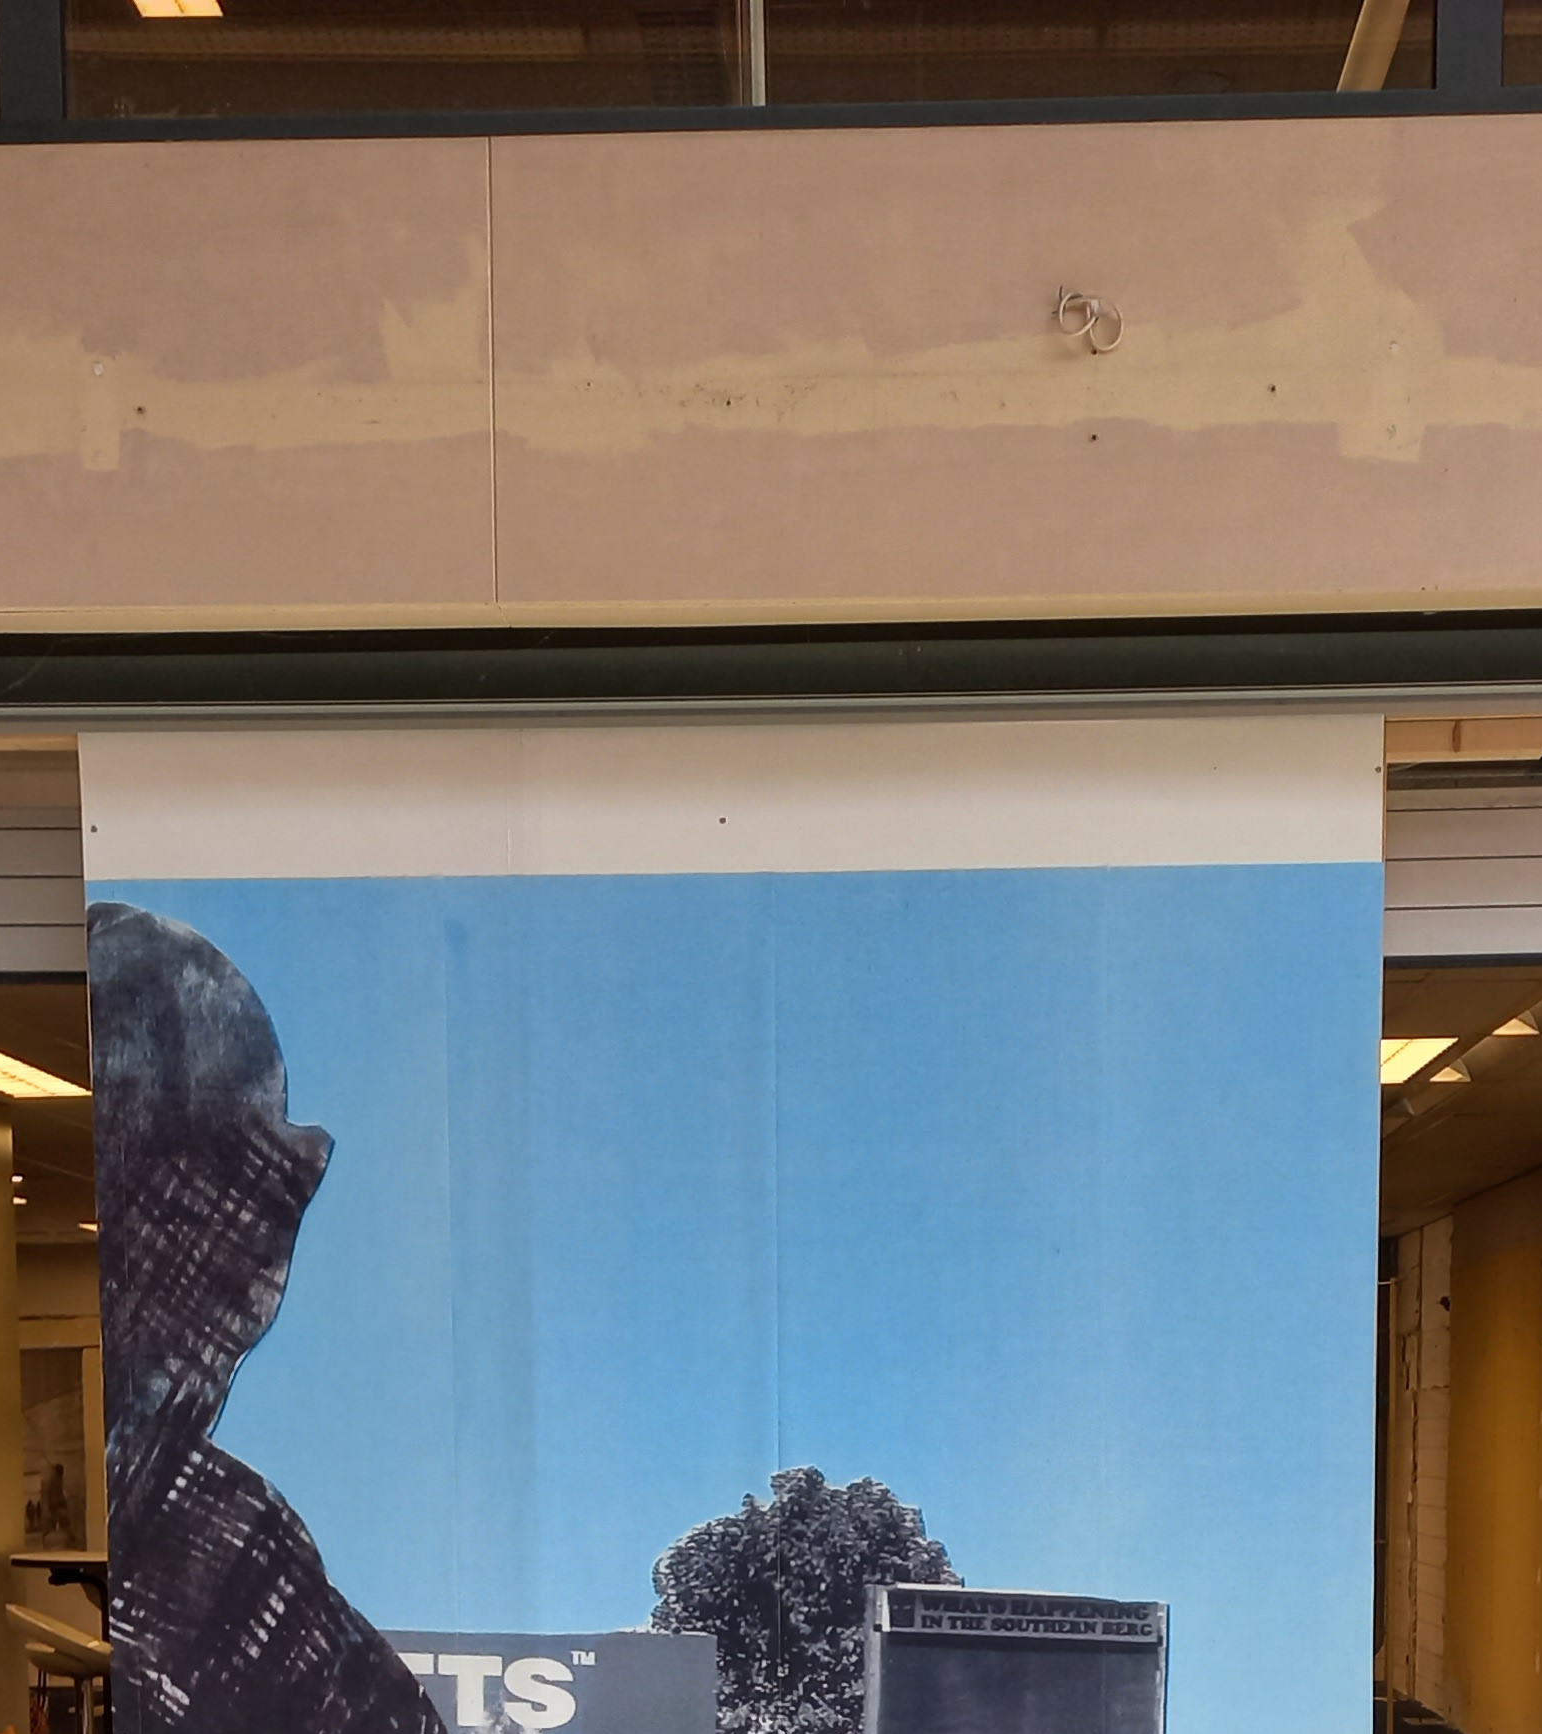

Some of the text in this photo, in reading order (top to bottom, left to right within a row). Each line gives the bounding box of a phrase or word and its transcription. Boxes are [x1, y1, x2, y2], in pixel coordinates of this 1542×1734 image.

[921, 1615, 1154, 1637] IN THE SOUTHERN BERG
[397, 1652, 576, 1729] TS
